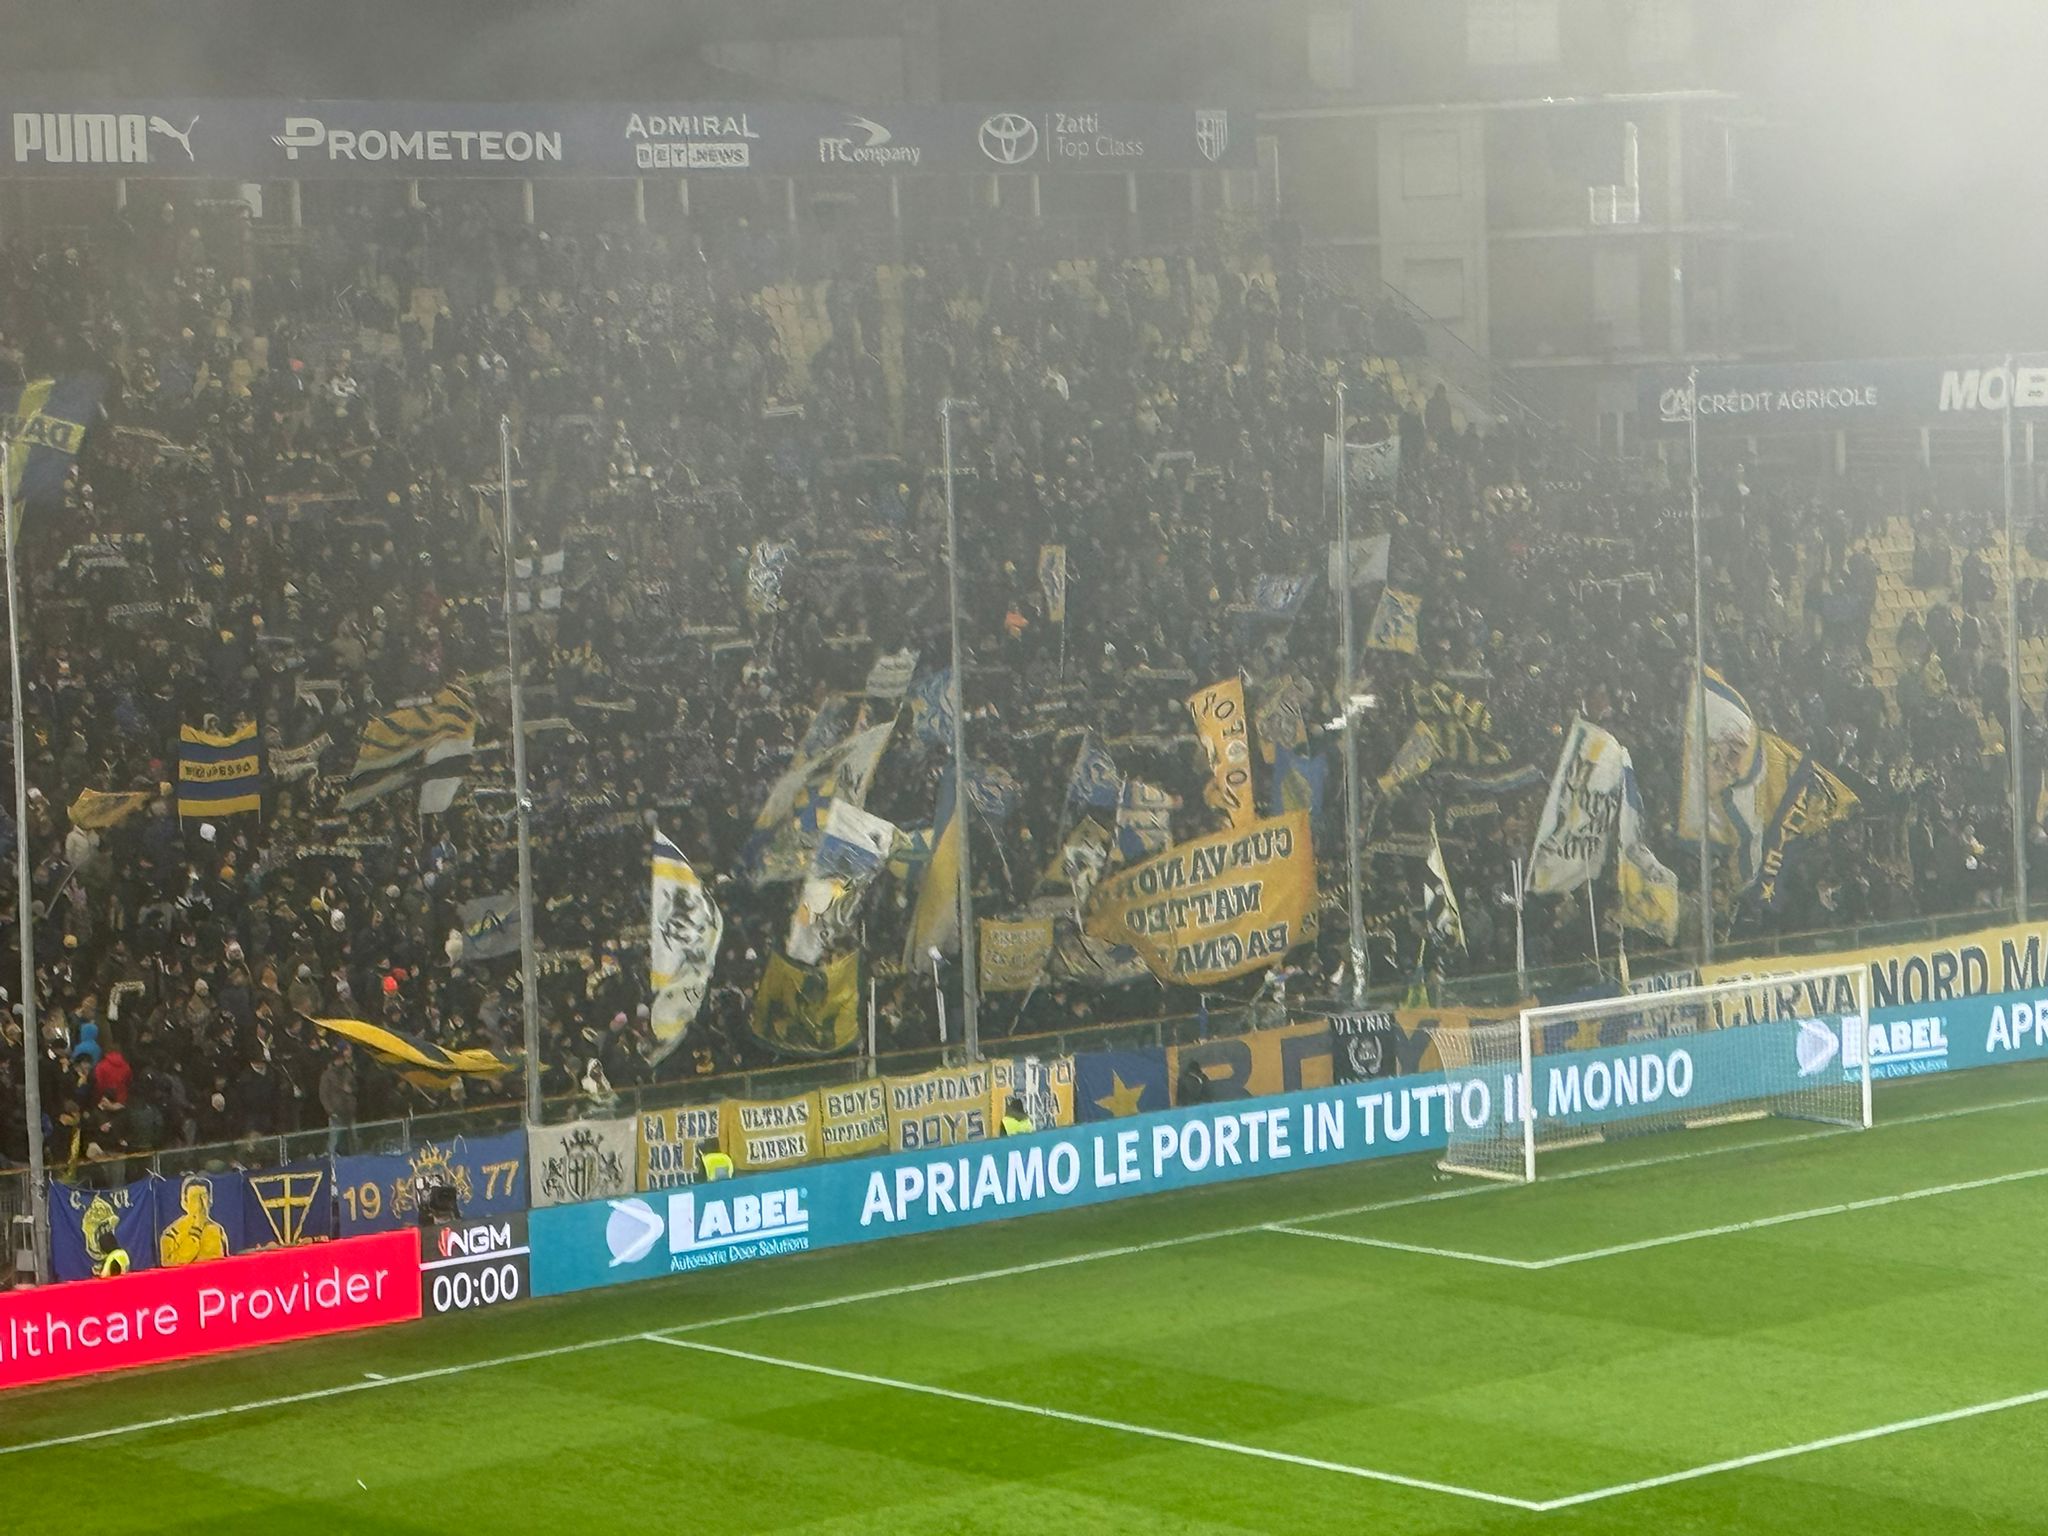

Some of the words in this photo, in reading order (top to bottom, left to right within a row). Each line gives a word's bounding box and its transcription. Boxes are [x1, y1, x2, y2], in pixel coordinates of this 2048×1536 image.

[13, 113, 148, 163] PUMA
[284, 116, 562, 161] PROMETEON
[625, 112, 760, 138] ADMIRAL
[1055, 112, 1098, 134] Zatti
[1057, 136, 1089, 160] Top
[1096, 135, 1144, 157] Class
[1777, 386, 1878, 411] AGRICOLE
[1871, 945, 1989, 1008] NORD
[740, 1100, 809, 1131] ULTRAS
[827, 1087, 882, 1118] BOYS
[860, 1142, 1080, 1226] APRIAMO
[1094, 1130, 1141, 1188] LE
[1153, 1107, 1291, 1178] PORTE
[1303, 1099, 1345, 1154] IN
[1356, 1079, 1491, 1145] TUTTO
[1549, 1049, 1693, 1116] MONDO
[900, 1109, 987, 1151] BOYS
[343, 1182, 381, 1221] 19
[482, 1160, 519, 1200] 77
[668, 1188, 809, 1254] LABEL
[433, 1263, 519, 1313] 00:00
[0, 1304, 178, 1362] lthcare
[198, 1263, 390, 1329] Provider
